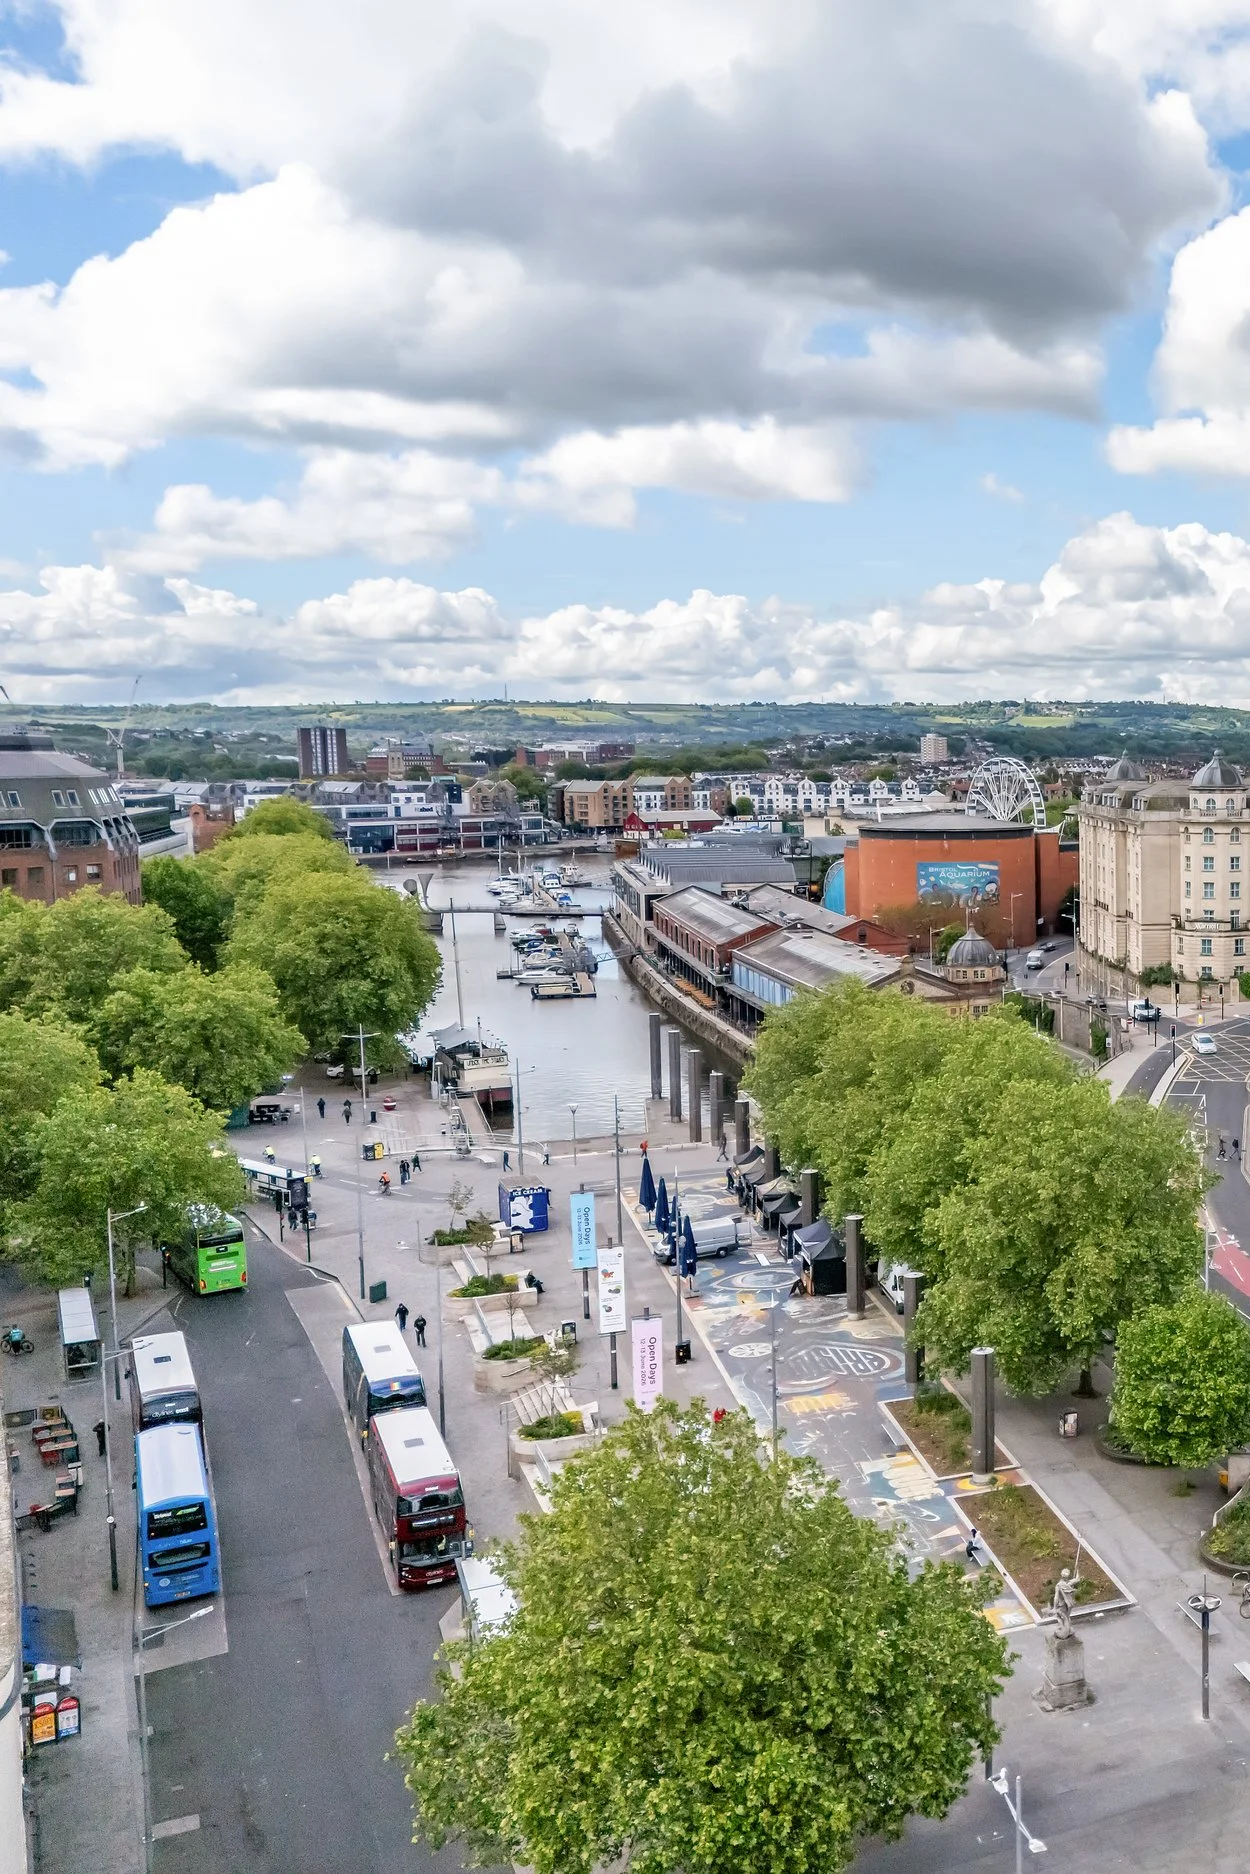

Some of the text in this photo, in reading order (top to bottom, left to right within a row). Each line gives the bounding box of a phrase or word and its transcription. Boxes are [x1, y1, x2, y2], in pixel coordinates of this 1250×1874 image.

[583, 1207, 591, 1245] Open Days
[648, 1337, 657, 1384] Open Days
